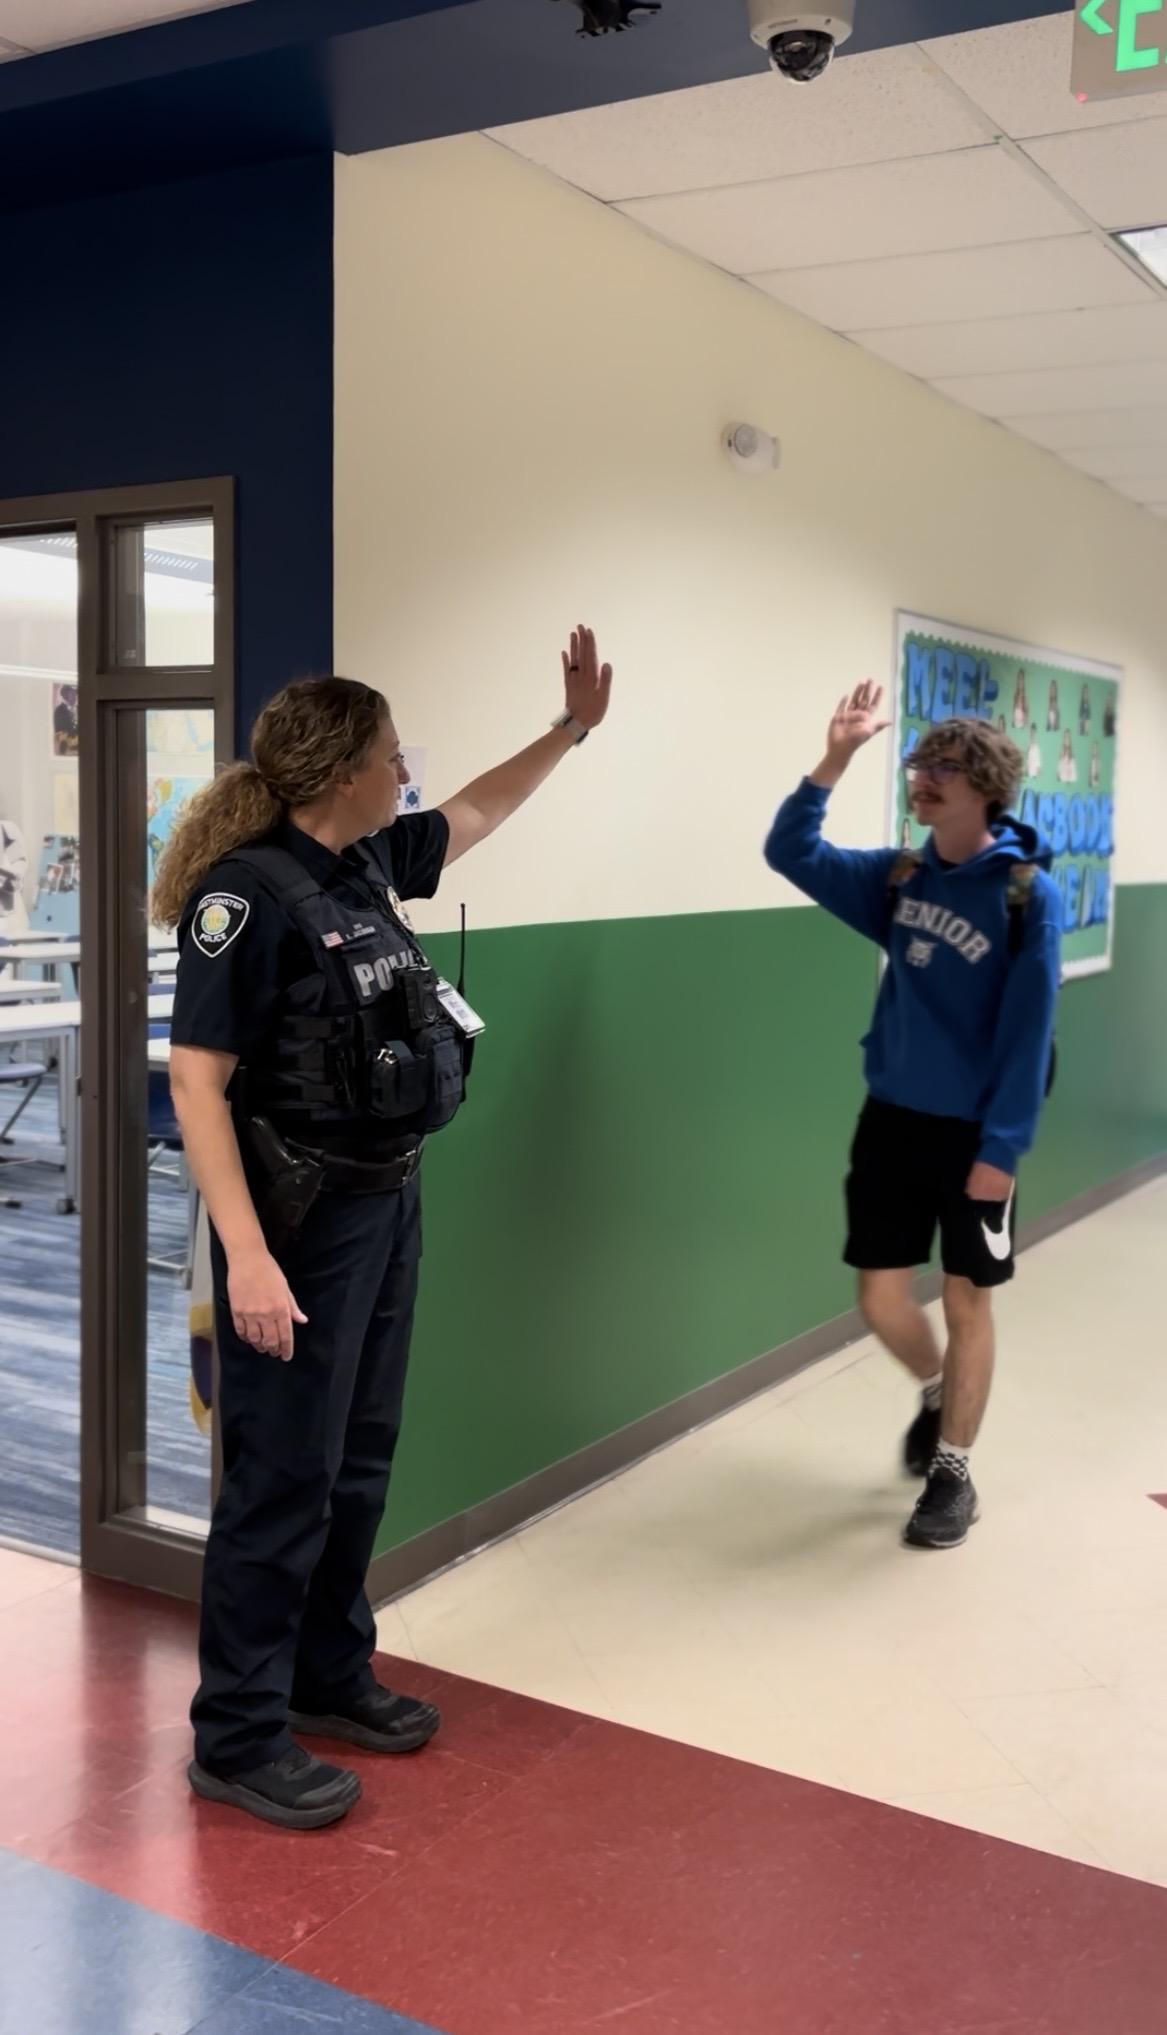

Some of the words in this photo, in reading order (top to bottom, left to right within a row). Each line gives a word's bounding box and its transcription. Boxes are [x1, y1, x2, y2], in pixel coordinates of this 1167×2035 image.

[1116, 0, 1167, 71] E
[199, 932, 228, 943] POLICE
[894, 896, 991, 965] ENIOR
